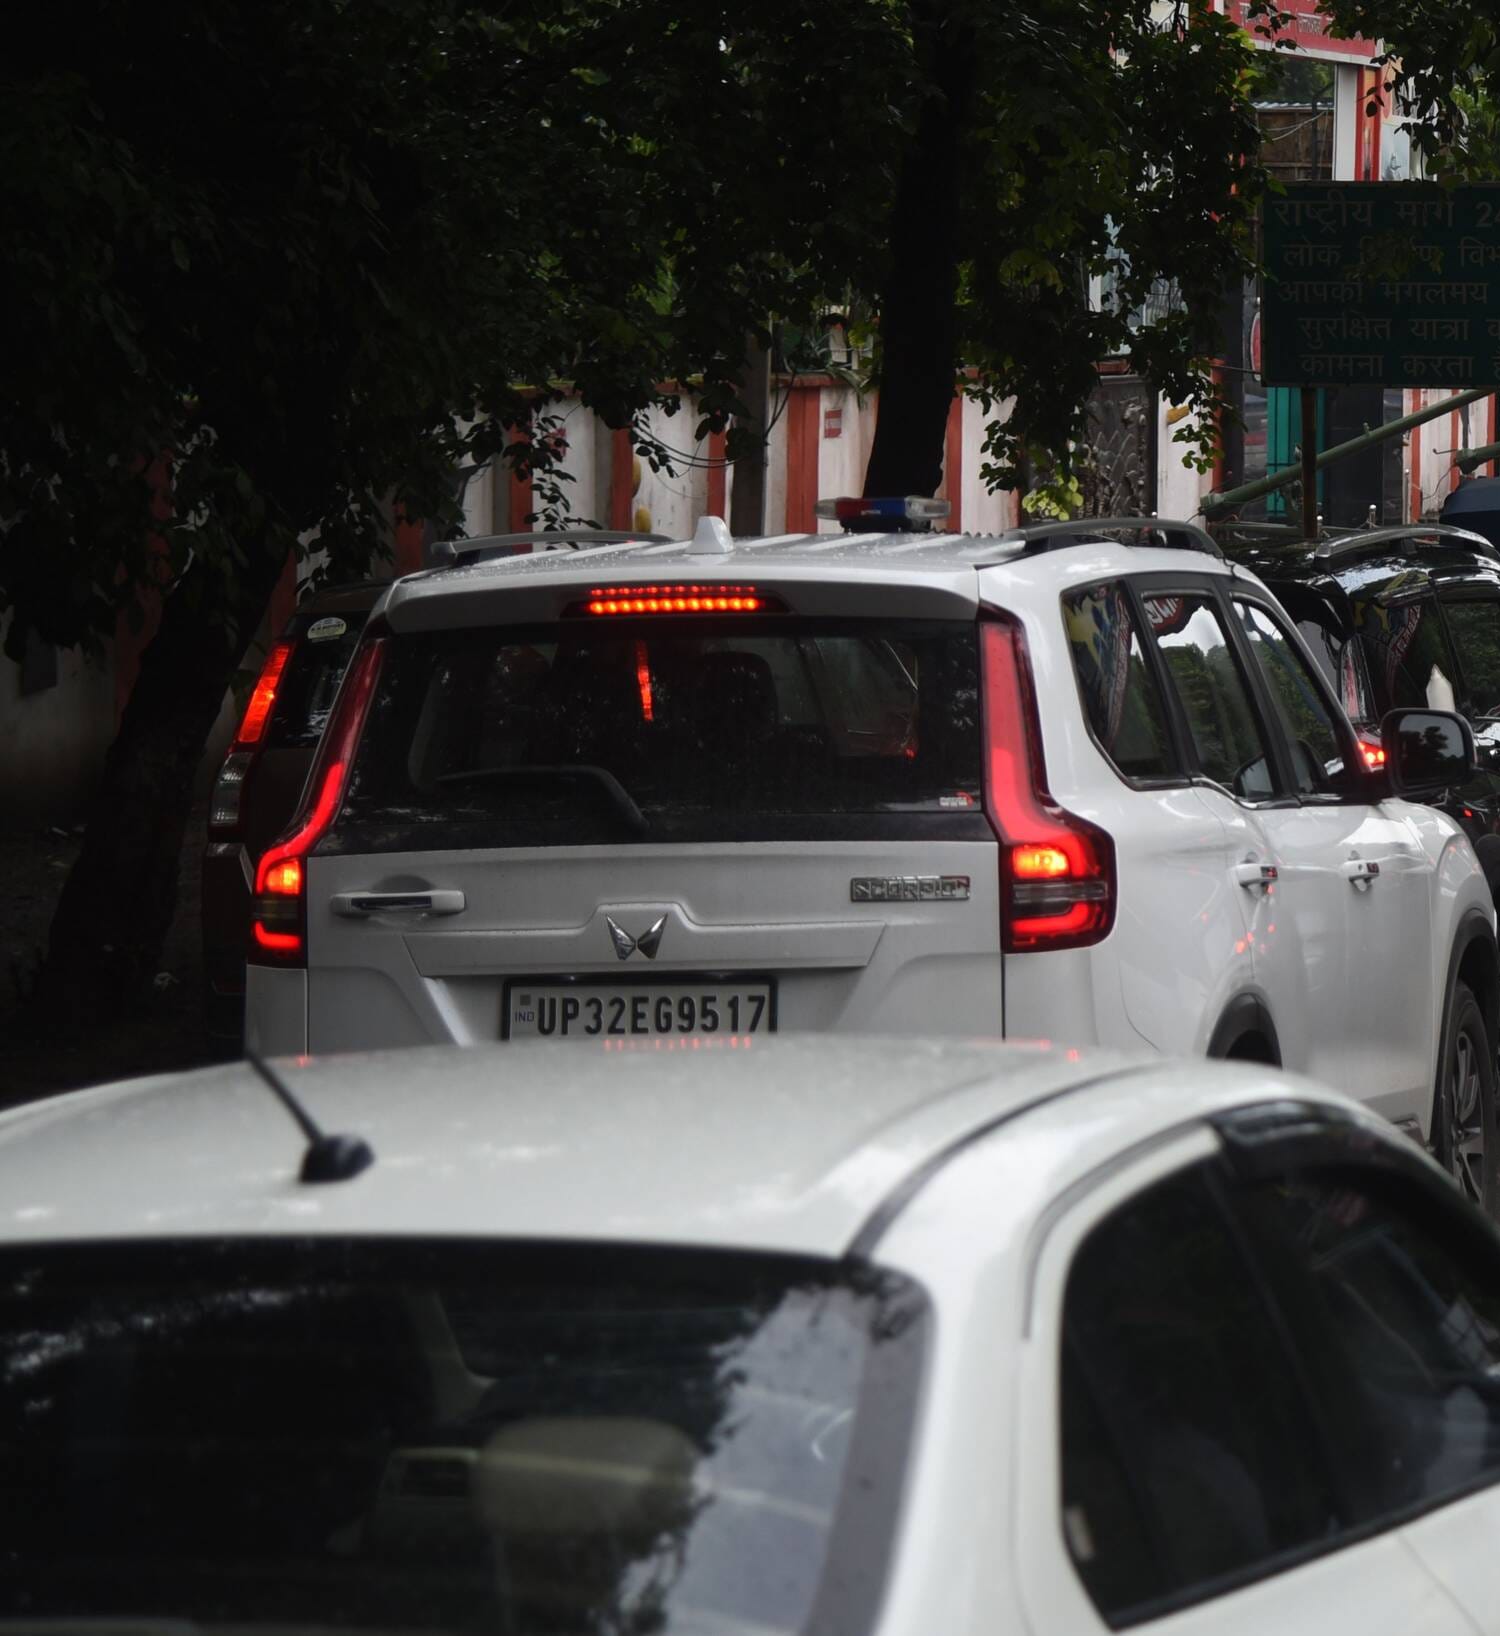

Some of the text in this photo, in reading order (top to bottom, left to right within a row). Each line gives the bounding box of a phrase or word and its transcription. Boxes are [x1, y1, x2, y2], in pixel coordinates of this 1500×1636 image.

[1271, 190, 1376, 233] राष्ट्रीय
[1280, 238, 1343, 268] लोक
[1297, 309, 1393, 349] सुरक्षित
[1408, 317, 1471, 342] यात्रा
[1299, 354, 1385, 379] कामना
[1400, 354, 1475, 379] करता
[514, 993, 767, 1036] IND UP32EG9517
